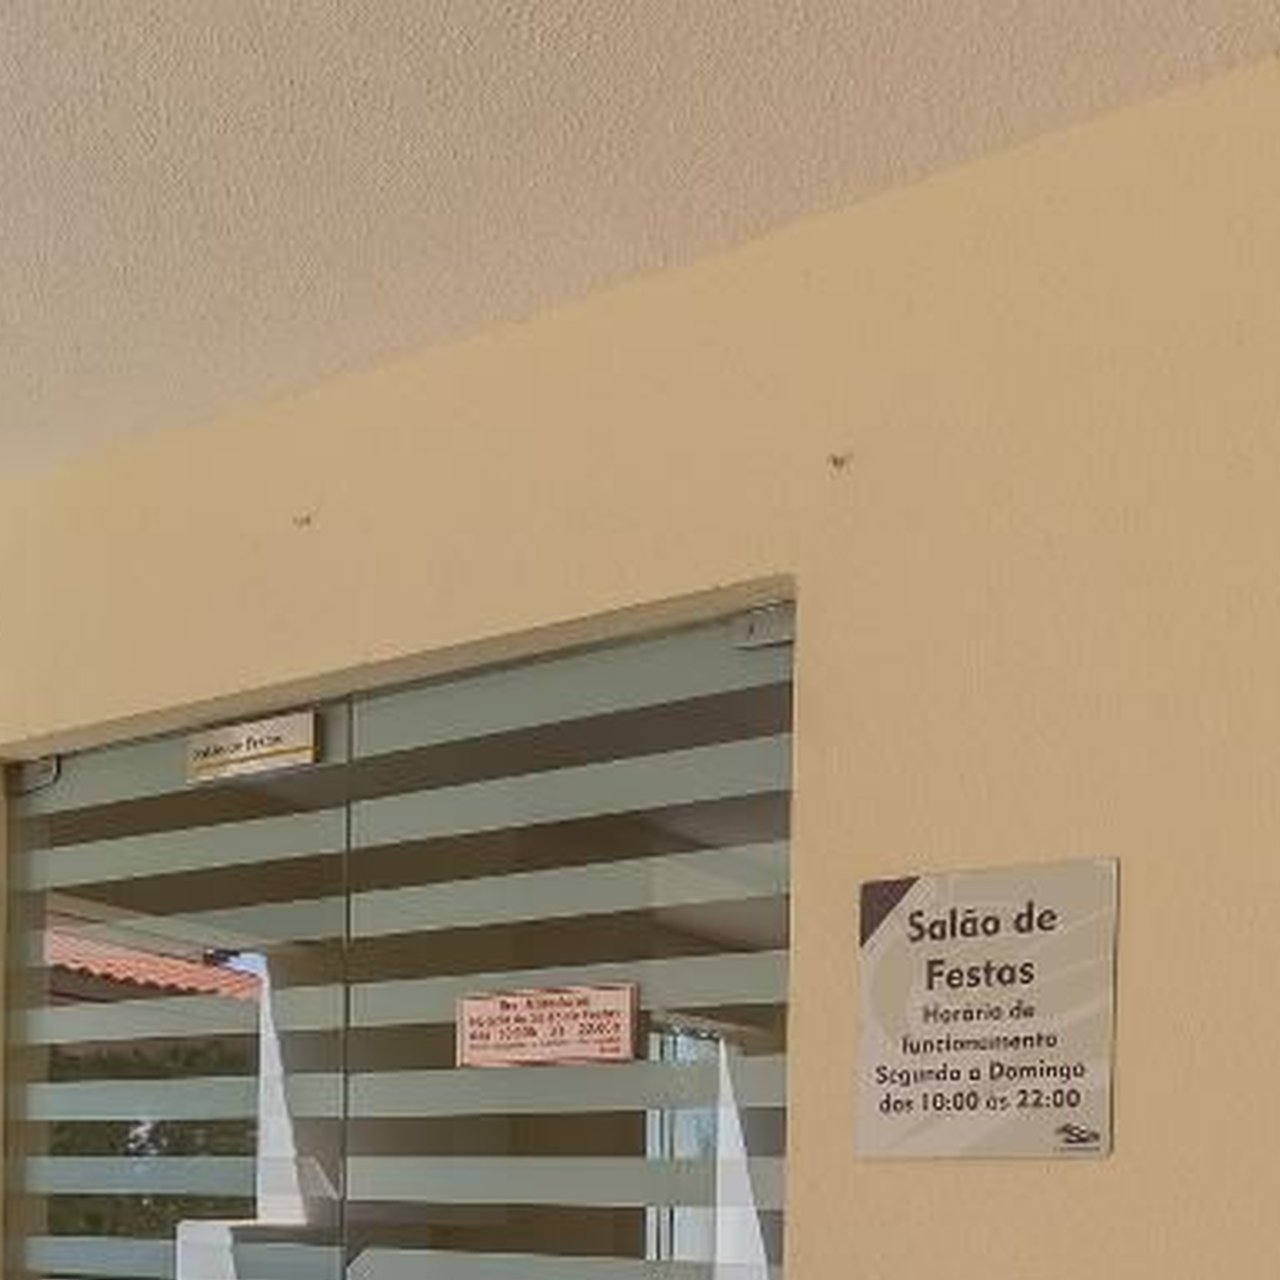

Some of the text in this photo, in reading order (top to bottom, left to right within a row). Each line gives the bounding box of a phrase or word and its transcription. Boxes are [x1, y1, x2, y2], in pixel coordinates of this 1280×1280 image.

[907, 900, 1058, 943] Salão de
[925, 958, 1036, 991] Festas
[968, 1067, 981, 1081] a
[989, 1059, 1086, 1083] Domingo
[922, 1091, 979, 1112] 10:00
[1016, 1088, 1081, 1109] 22:00
